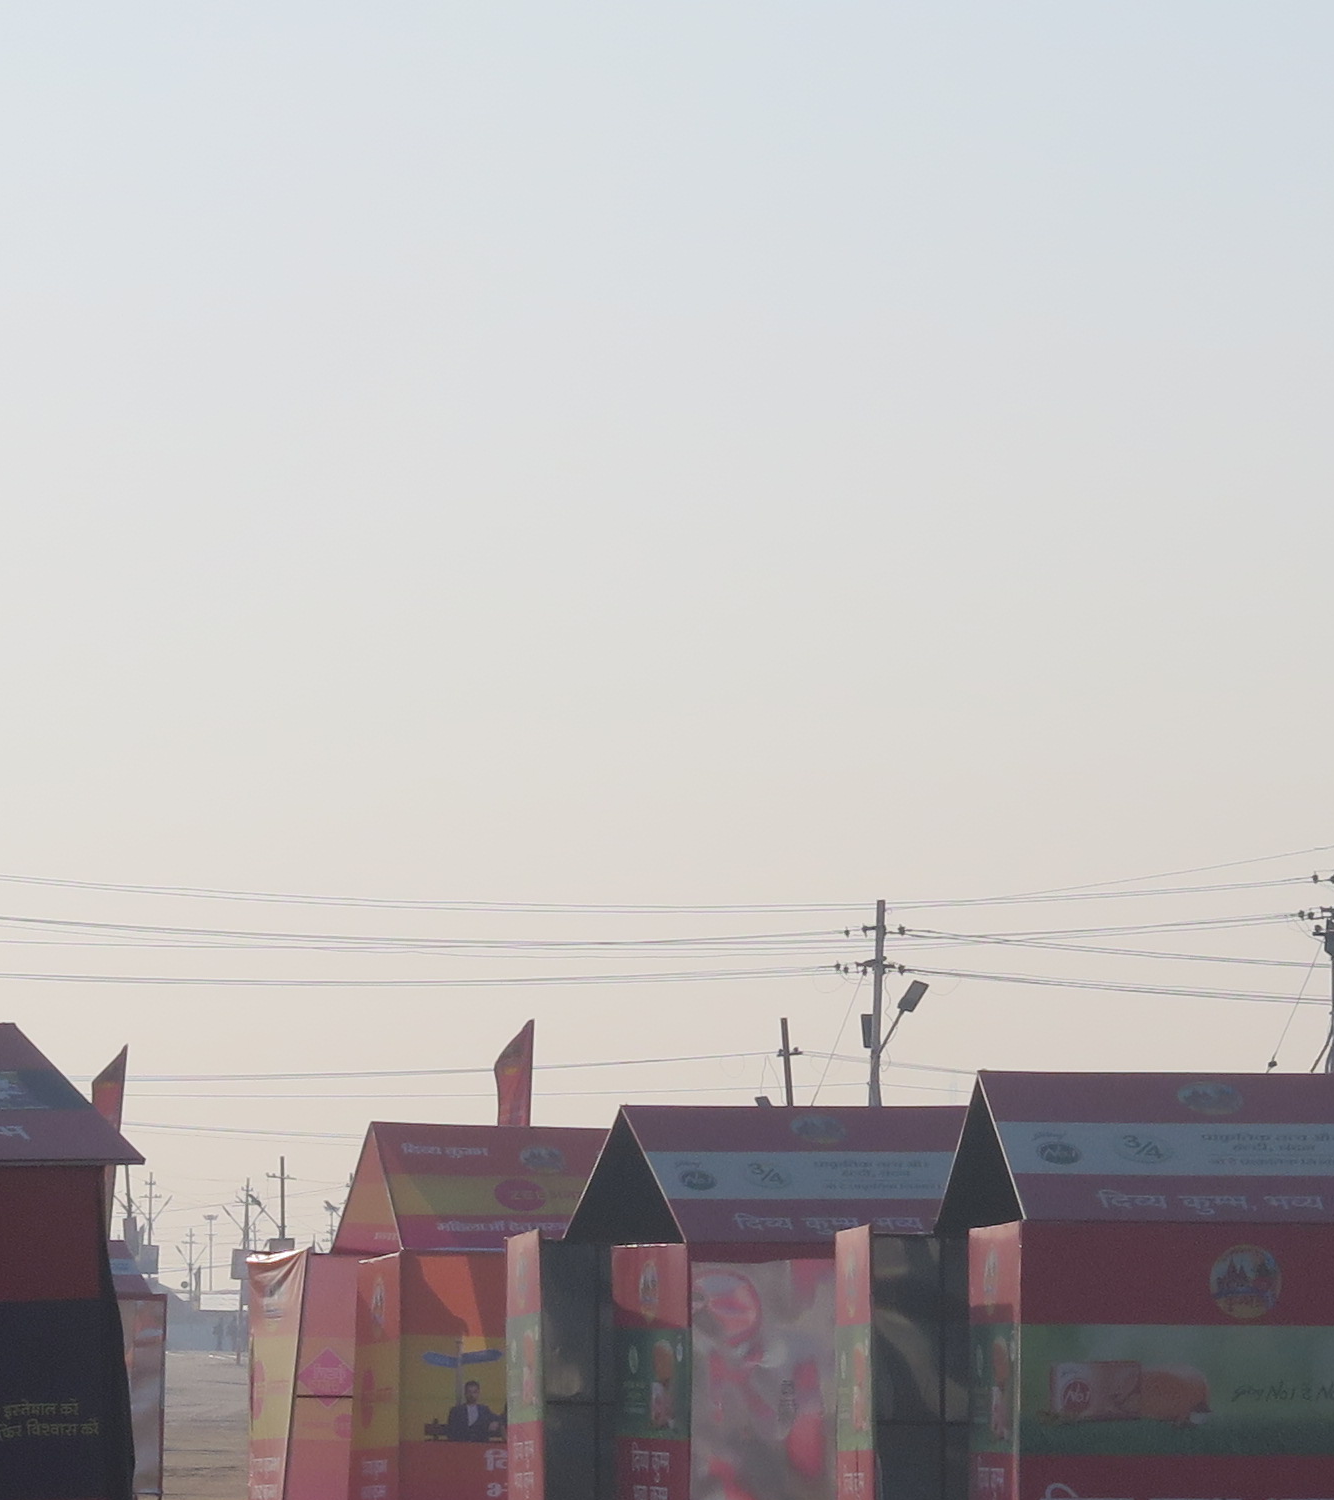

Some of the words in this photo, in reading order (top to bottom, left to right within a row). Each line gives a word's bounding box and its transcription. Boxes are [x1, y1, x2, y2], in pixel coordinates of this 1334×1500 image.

[1121, 1135, 1163, 1158] 3/4
[1096, 1189, 1167, 1210] दिव्य
[1178, 1194, 1257, 1215] कुम्भ,
[1263, 1195, 1323, 1210] भव्य
